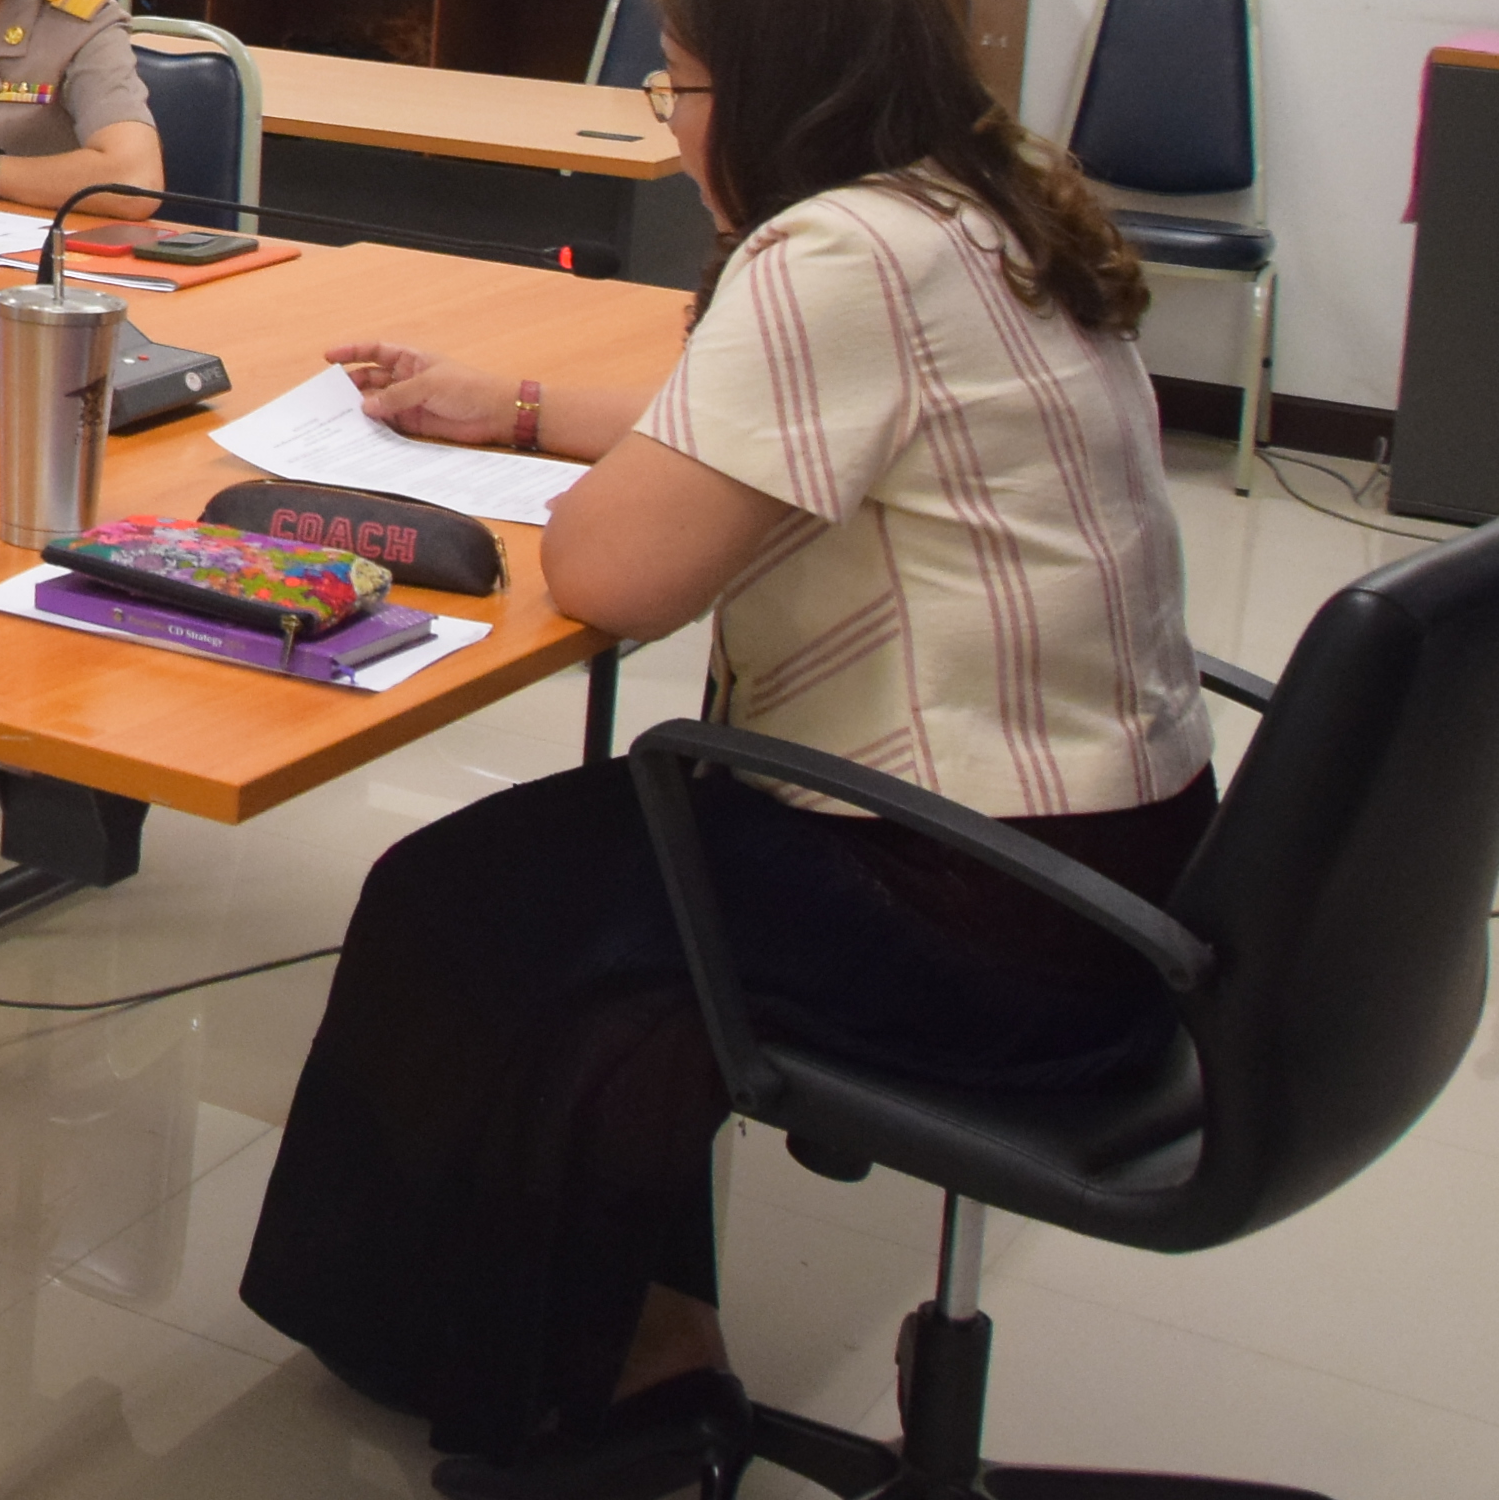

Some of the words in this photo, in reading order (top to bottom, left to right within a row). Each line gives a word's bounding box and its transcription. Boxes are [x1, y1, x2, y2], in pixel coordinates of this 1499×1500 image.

[270, 508, 418, 564] COACH
[168, 624, 184, 636] CD
[185, 629, 223, 648] Strategy
